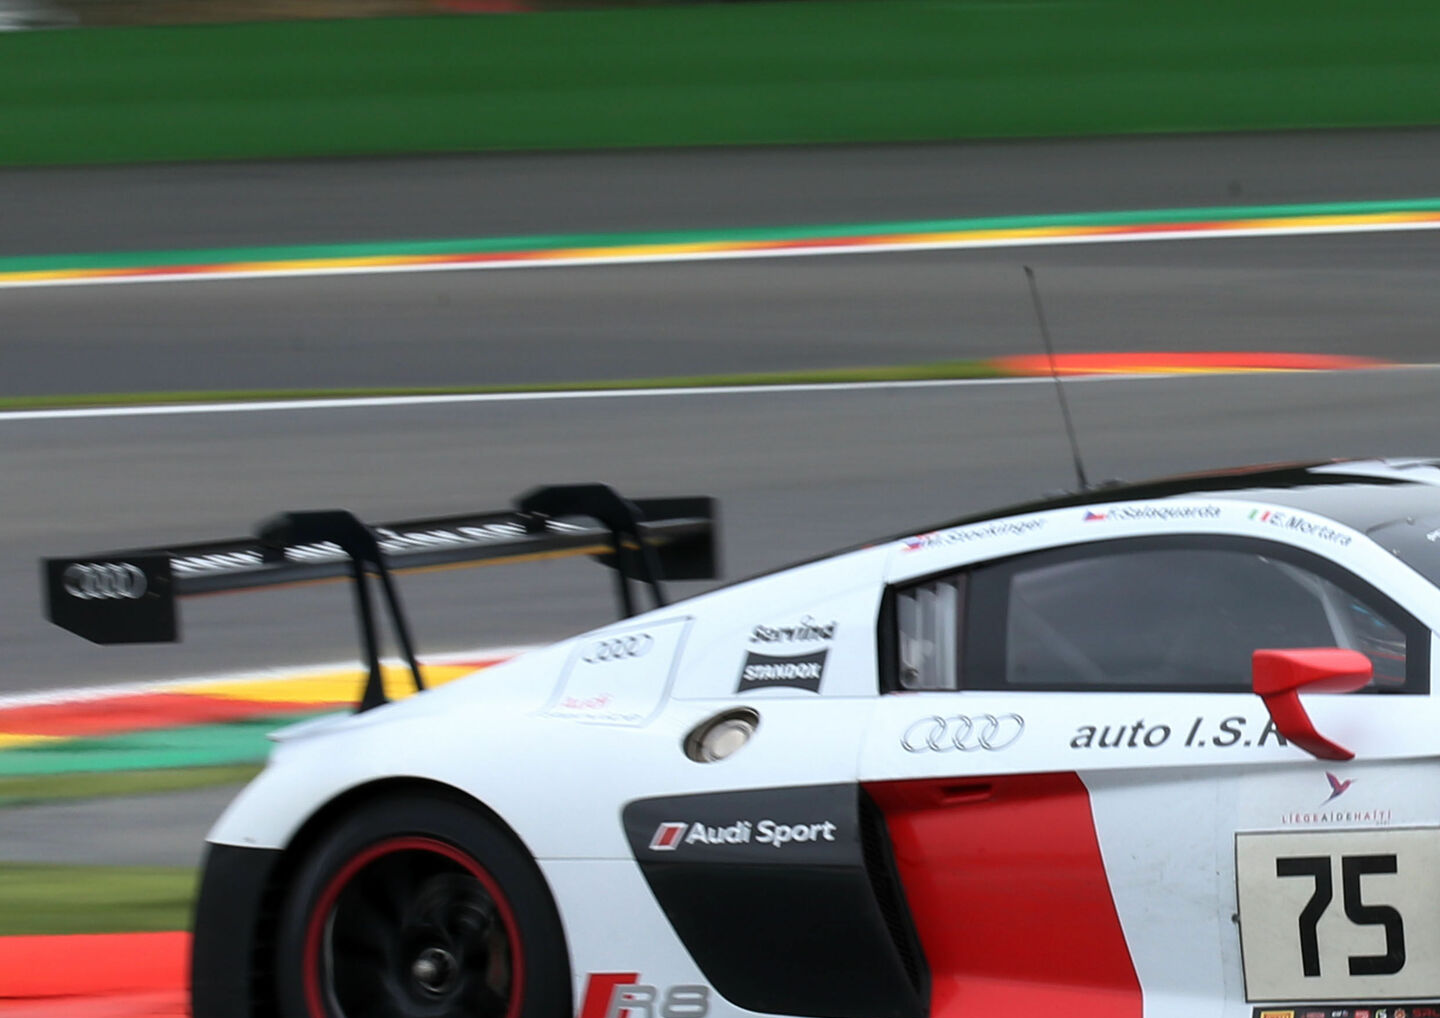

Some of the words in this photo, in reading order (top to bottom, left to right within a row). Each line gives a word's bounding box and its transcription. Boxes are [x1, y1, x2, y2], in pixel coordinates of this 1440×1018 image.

[1069, 718, 1173, 749] auto
[685, 821, 752, 845] Audi
[755, 820, 837, 848] Sport
[1275, 853, 1407, 978] 75
